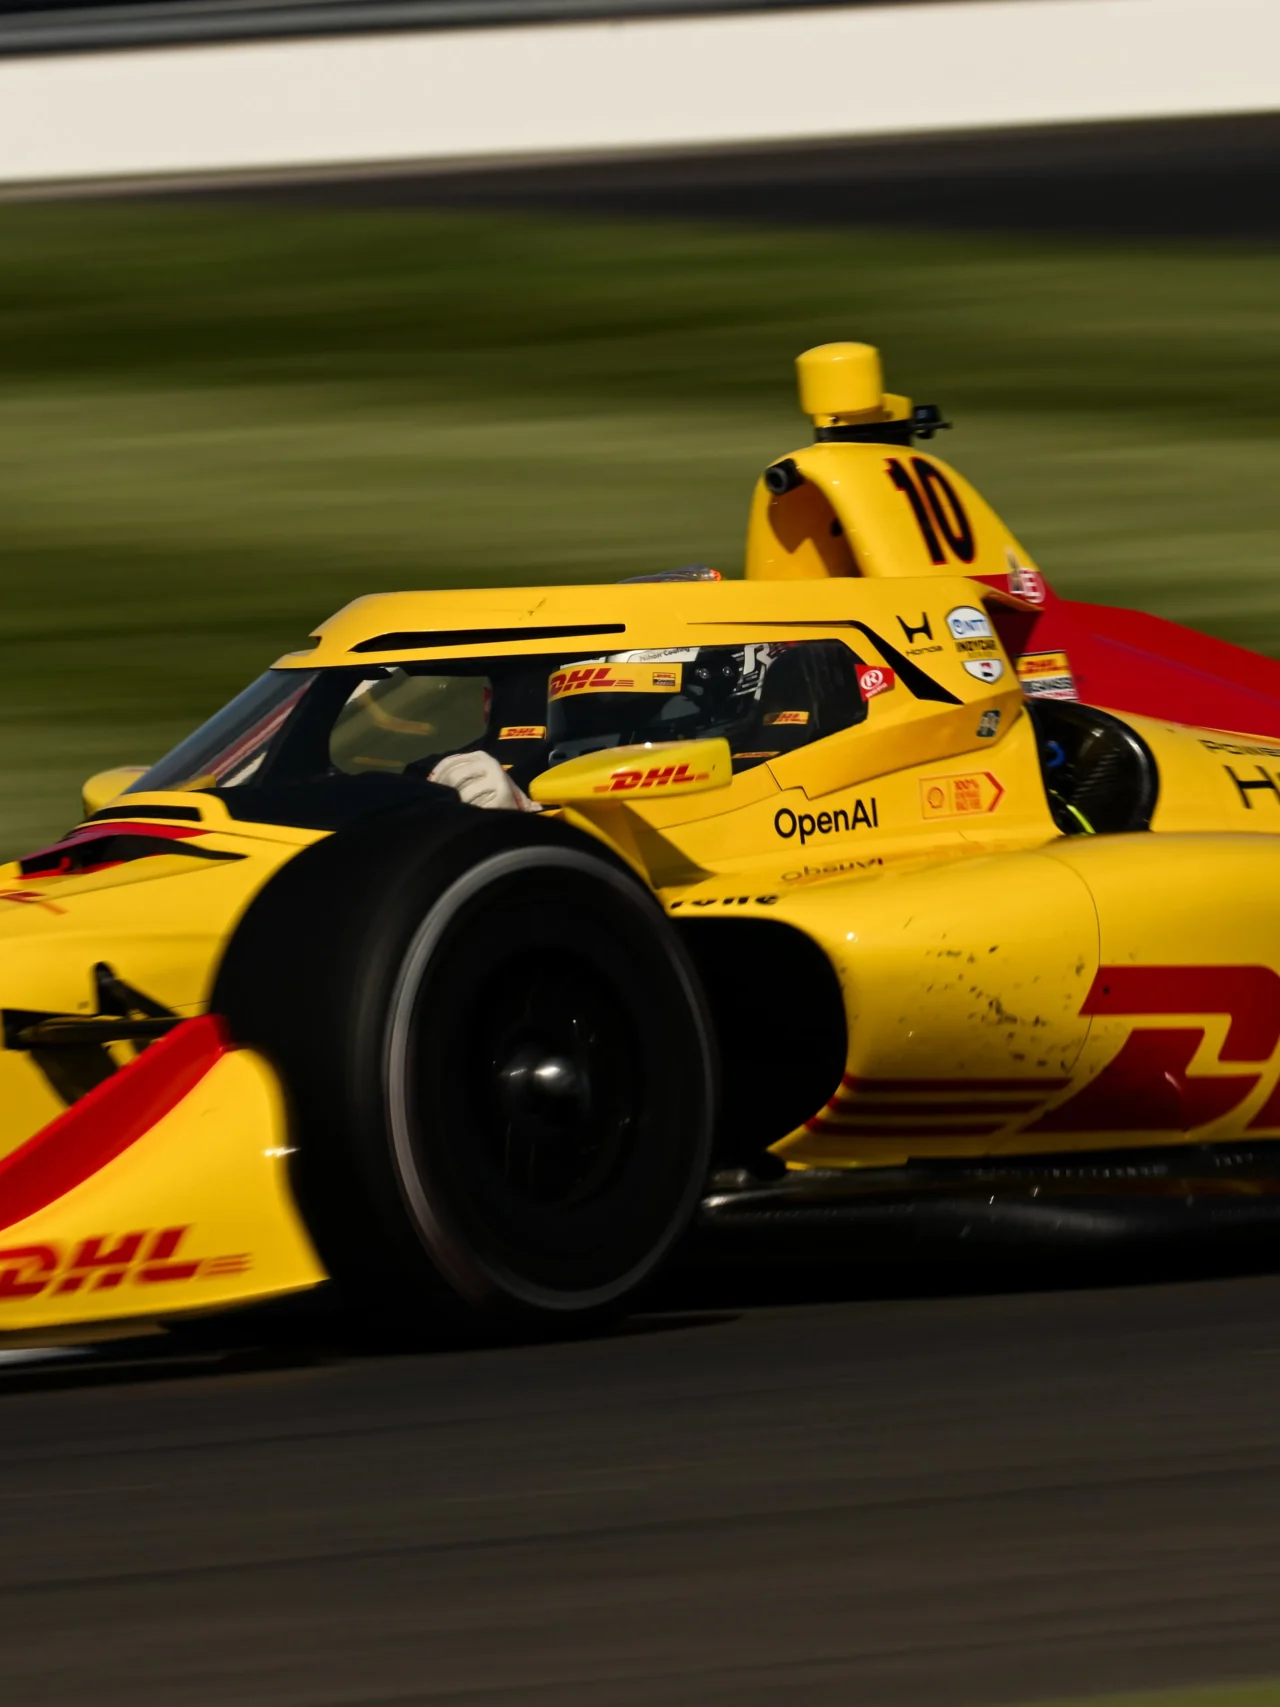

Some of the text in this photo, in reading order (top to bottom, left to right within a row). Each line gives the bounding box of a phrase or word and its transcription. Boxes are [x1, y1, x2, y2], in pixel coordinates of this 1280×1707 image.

[883, 456, 975, 566] 10
[549, 667, 617, 700] DHL
[506, 728, 536, 737] DHL
[608, 764, 696, 792] DHL
[1222, 765, 1280, 809] H
[774, 797, 879, 845] OpenAI
[1016, 965, 1280, 1133] D
